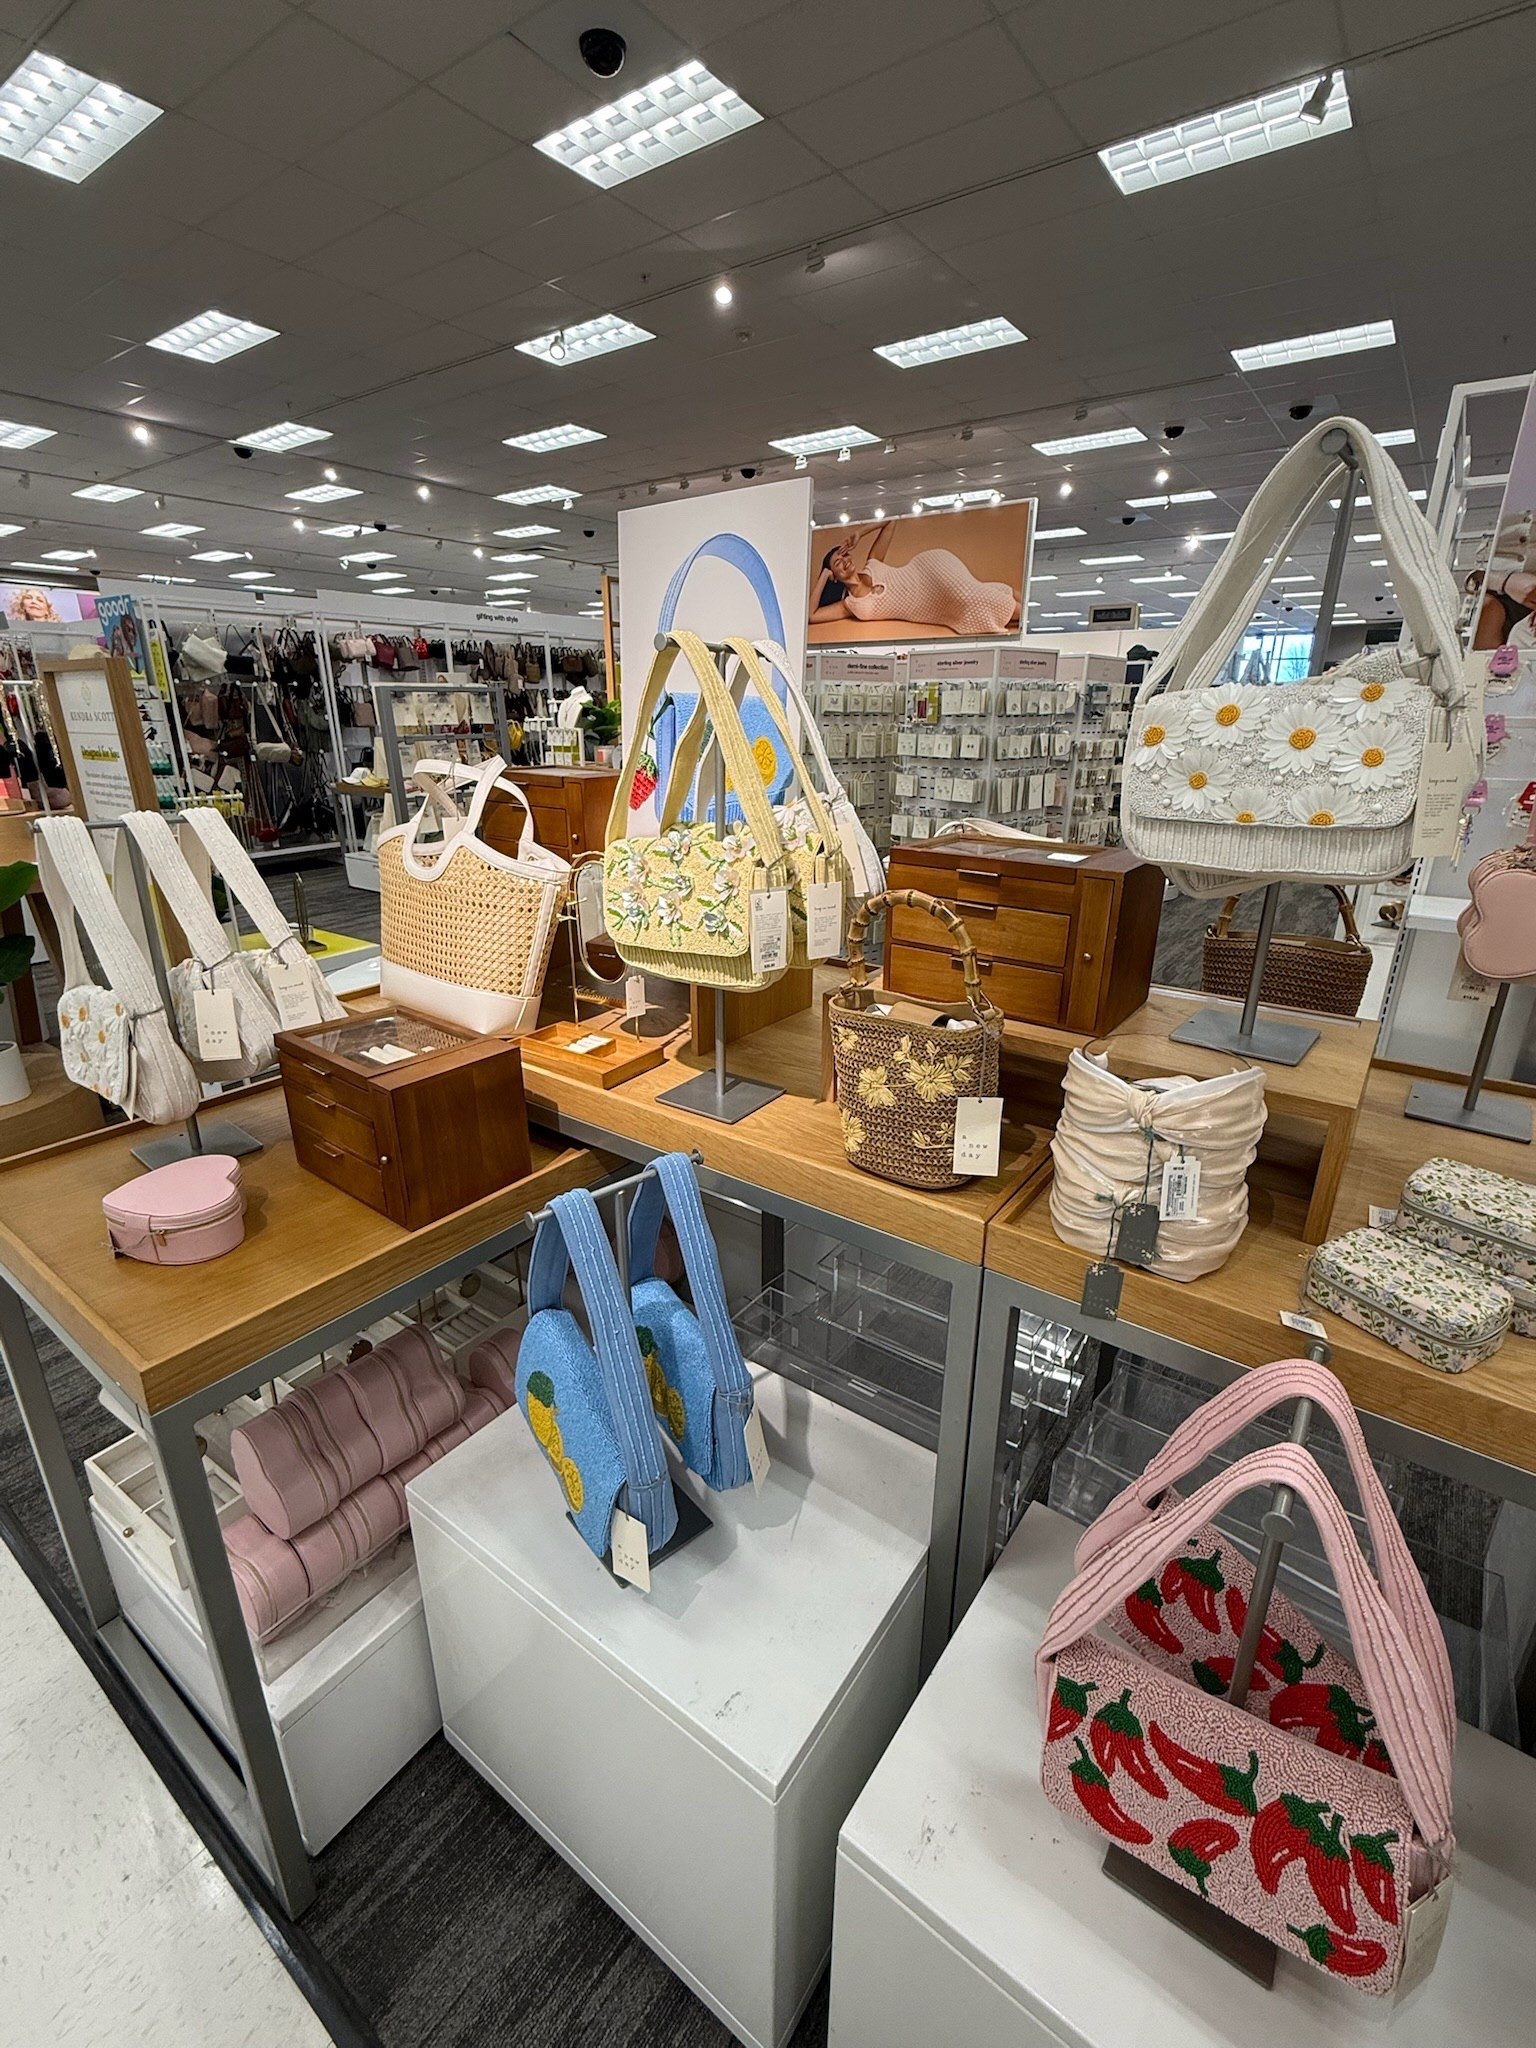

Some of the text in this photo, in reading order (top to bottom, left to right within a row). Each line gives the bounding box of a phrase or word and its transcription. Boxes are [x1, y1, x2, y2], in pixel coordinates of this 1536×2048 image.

[98, 598, 130, 626] goodr
[476, 613, 493, 621] gifting
[70, 711, 115, 722] KENDRA SCOTT
